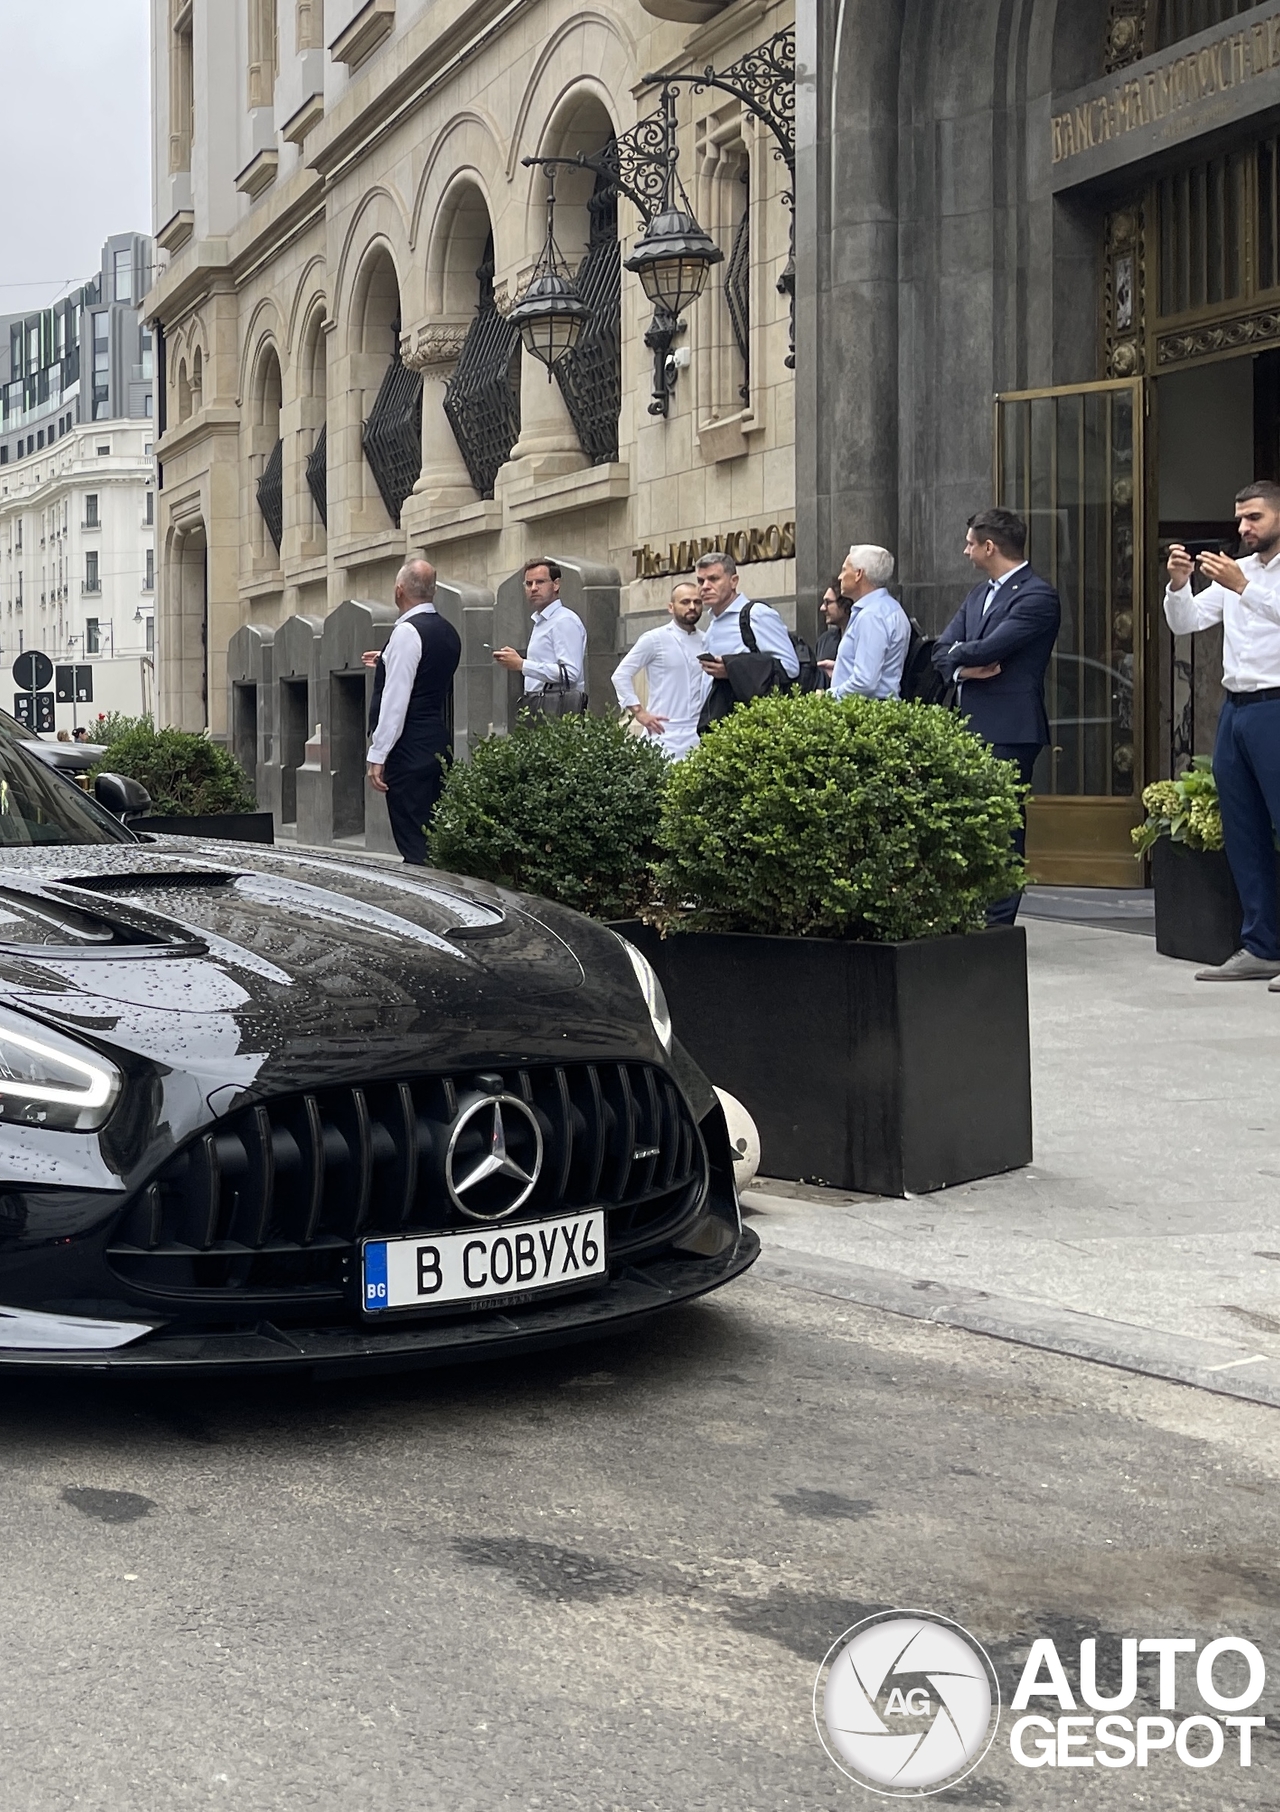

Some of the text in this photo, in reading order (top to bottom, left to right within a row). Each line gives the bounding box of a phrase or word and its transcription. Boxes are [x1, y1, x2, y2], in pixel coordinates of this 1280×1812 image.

[632, 544, 661, 578] The
[416, 1219, 599, 1296] B COBYX6
[367, 1282, 386, 1299] BG
